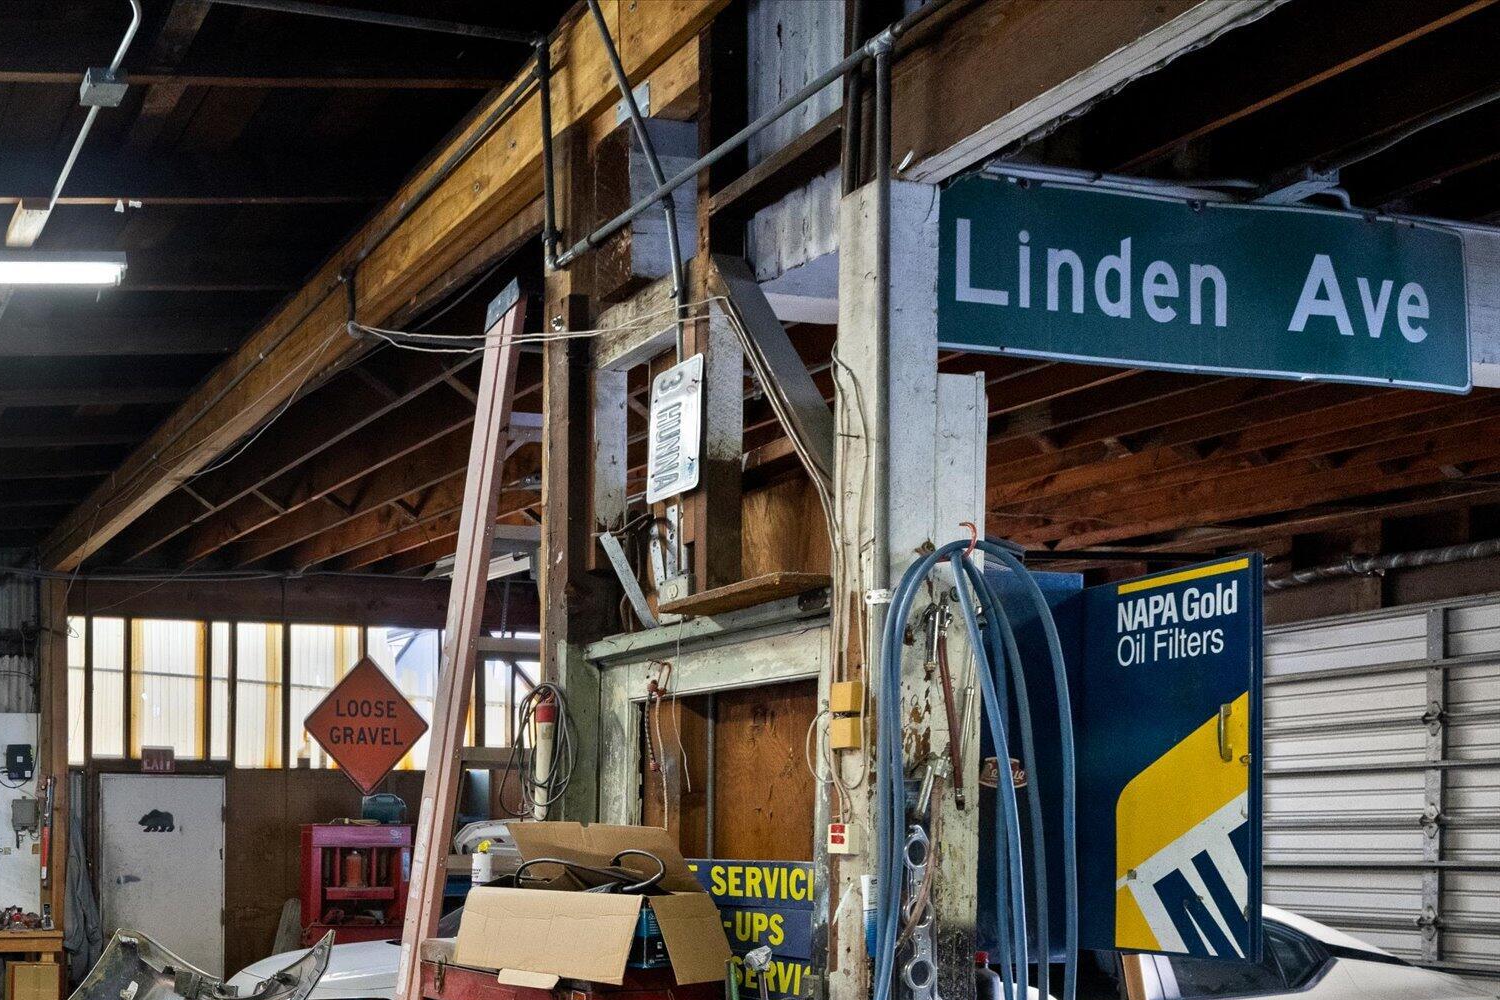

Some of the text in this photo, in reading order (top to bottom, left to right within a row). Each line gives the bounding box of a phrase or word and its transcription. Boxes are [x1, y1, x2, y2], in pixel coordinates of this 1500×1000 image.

[955, 217, 1430, 343] Linden Ave
[654, 371, 683, 493] 3 HUNNA
[1117, 580, 1238, 633] NAPA Gold
[1117, 627, 1224, 667] Oil Filters
[336, 700, 397, 718] LOOSE
[330, 726, 403, 745] GRAVEL
[723, 911, 785, 946] -UPS
[730, 956, 811, 996] SERVI
